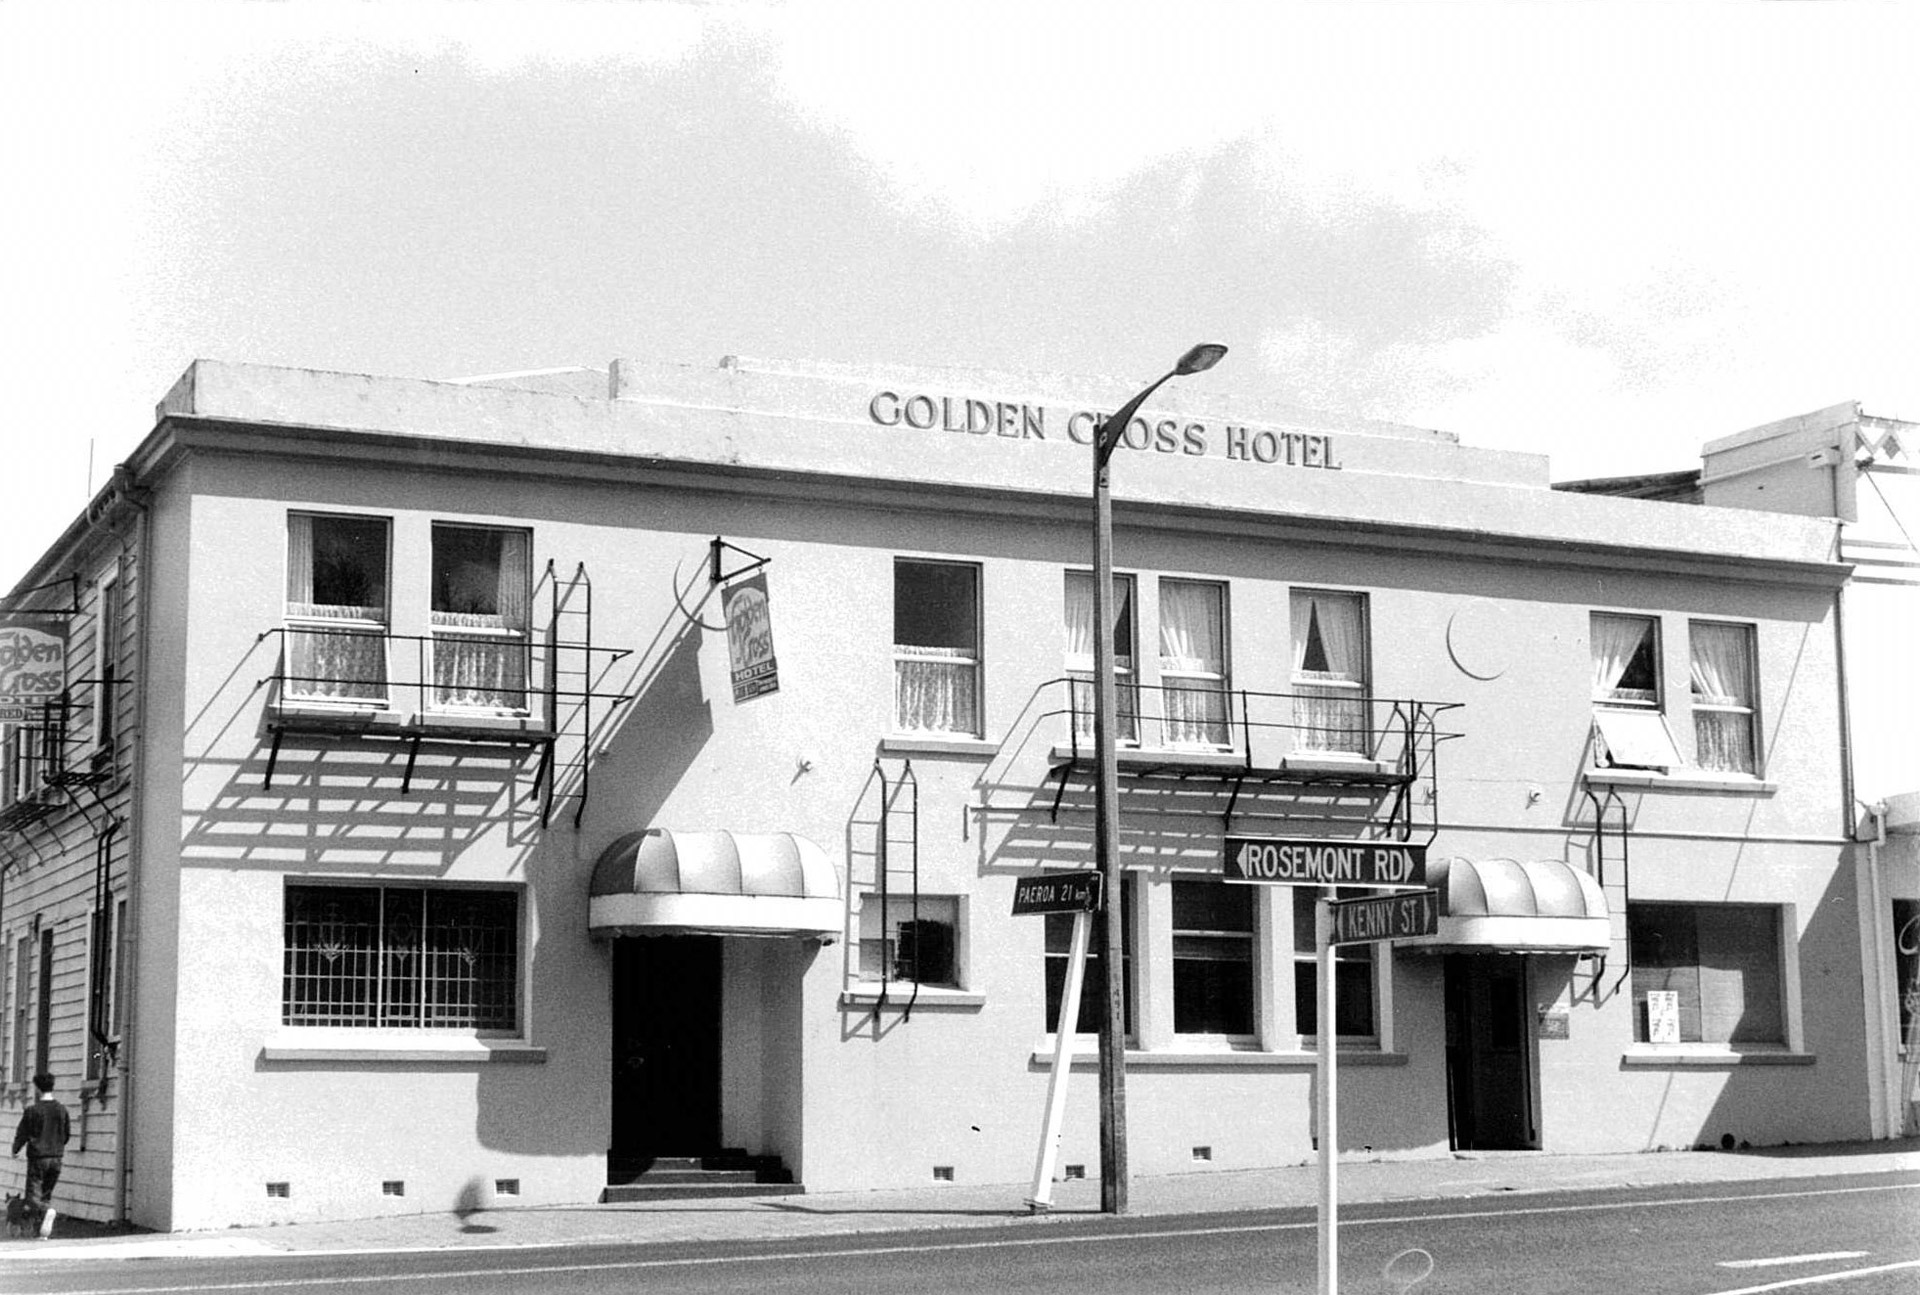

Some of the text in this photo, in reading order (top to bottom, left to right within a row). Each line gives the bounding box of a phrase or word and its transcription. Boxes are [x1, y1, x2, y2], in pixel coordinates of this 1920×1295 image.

[869, 391, 1342, 470] GOLDEN COSS HOTEL
[734, 661, 775, 681] HOTEL
[1248, 844, 1404, 881] ROSEMONT RD
[1018, 884, 1055, 904] PAEROA
[1060, 883, 1073, 902] 21
[1348, 898, 1418, 938] KENNY ST
